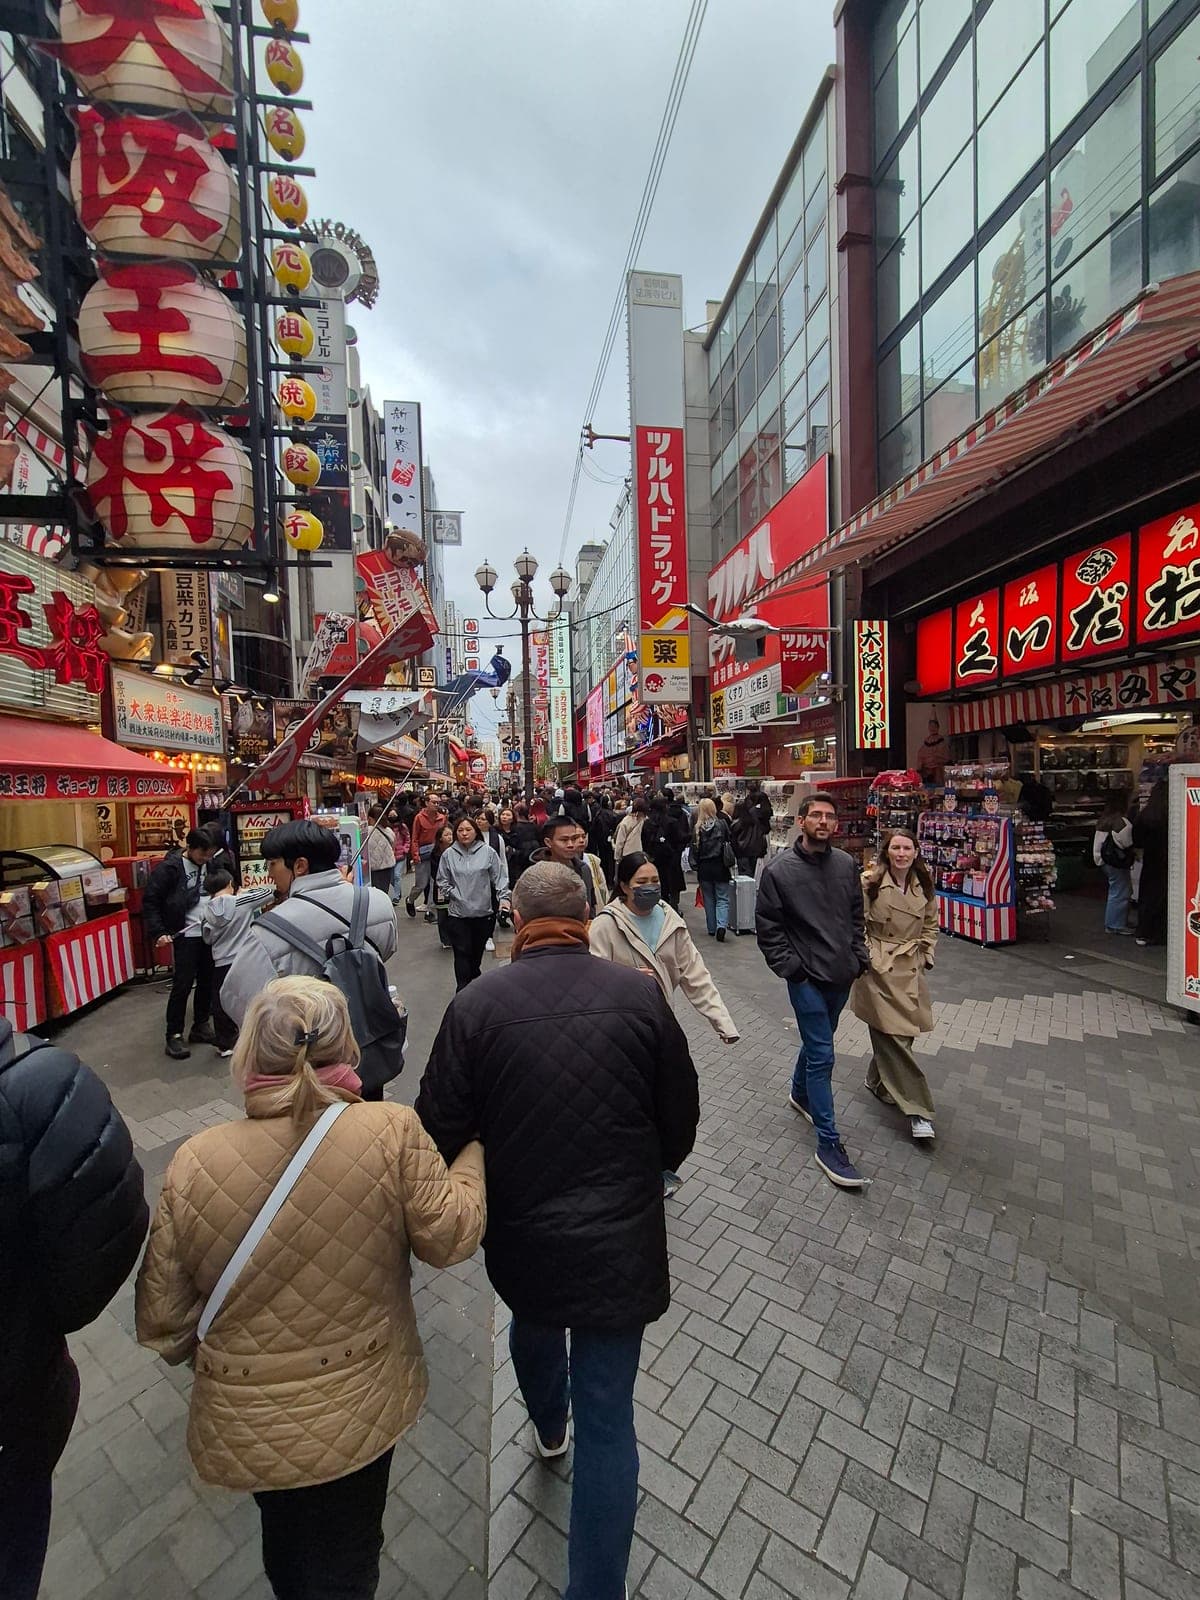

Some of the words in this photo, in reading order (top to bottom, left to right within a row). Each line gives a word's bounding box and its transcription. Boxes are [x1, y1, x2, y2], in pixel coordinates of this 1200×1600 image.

[36, 0, 238, 542] 大阪王将
[320, 464, 347, 472] CEAN
[647, 432, 677, 605] ツルハドラッグ
[176, 572, 194, 651] 豆柴カフェ
[781, 634, 826, 648] ツルハ
[653, 639, 677, 664] 薬
[783, 651, 817, 662] ドラッグ
[751, 674, 768, 691] 化粧品
[862, 628, 885, 741] 大阪みやげ
[1066, 666, 1197, 708] 大阪みや
[728, 685, 743, 700] くすり
[136, 779, 175, 794] GYOZA
[143, 805, 182, 818] NINJA
